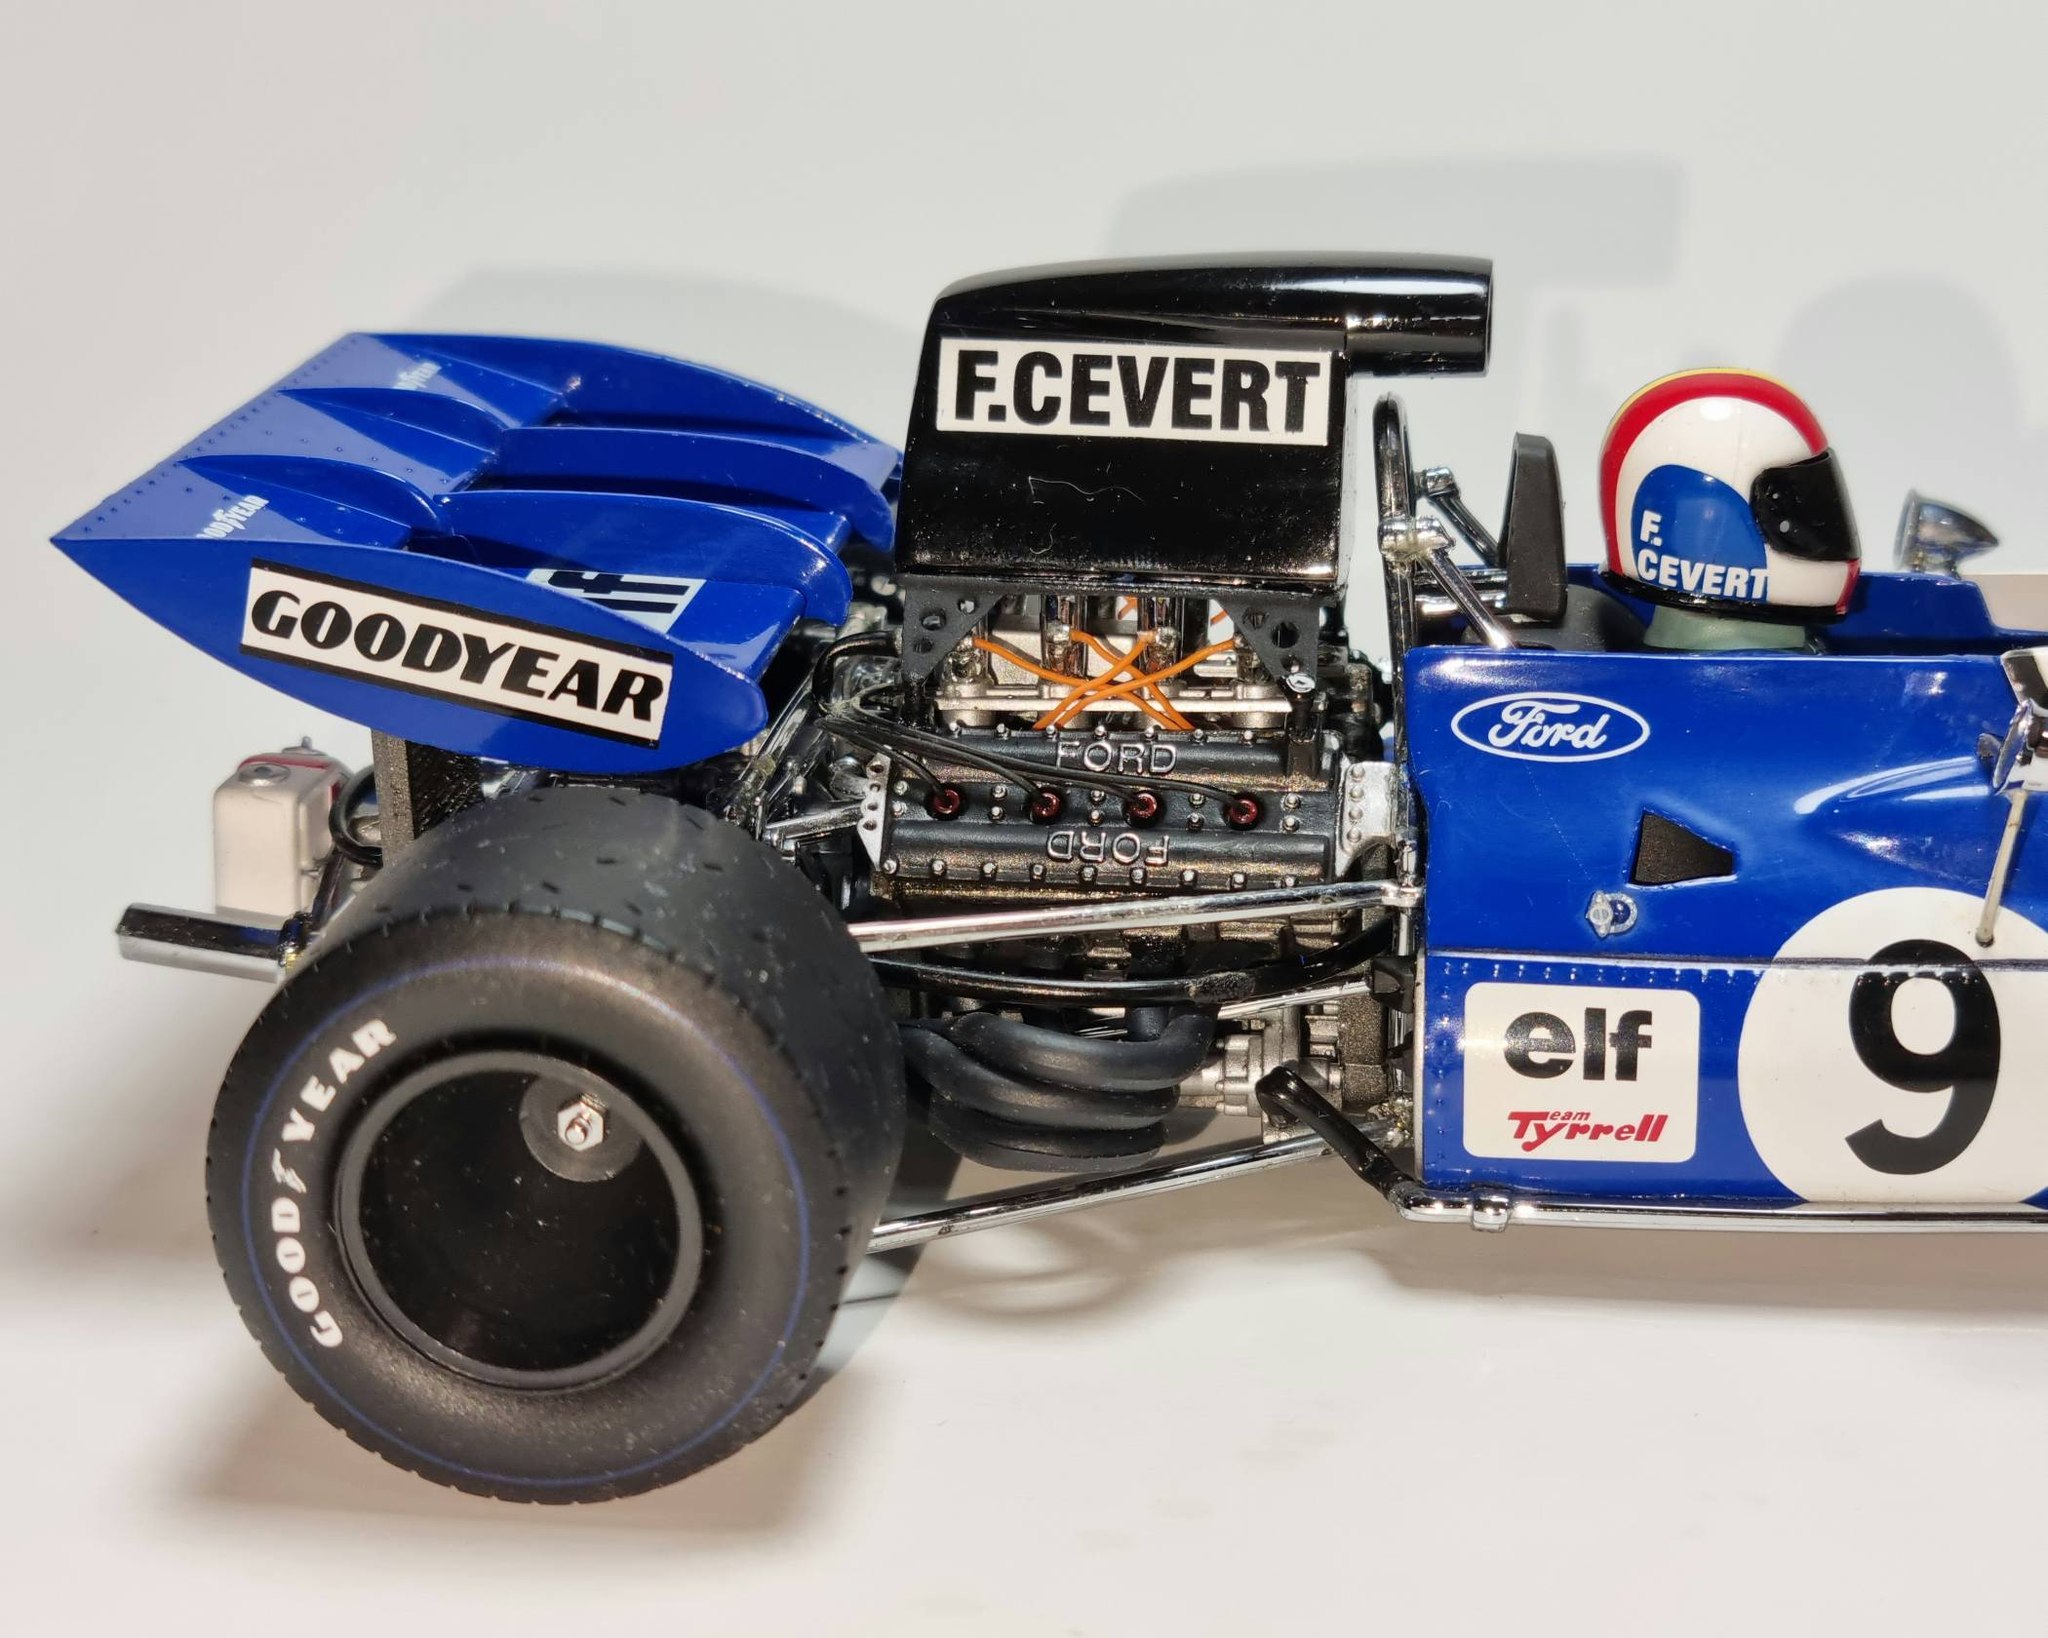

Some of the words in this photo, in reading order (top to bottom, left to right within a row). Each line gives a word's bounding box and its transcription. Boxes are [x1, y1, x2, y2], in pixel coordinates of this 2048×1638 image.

[954, 349, 1321, 433] F.CEVERT
[1640, 509, 1663, 547] F.
[1637, 548, 1769, 600] CEVERT
[251, 589, 664, 722] GOODYEAR
[1487, 700, 1611, 750] Ford
[1056, 740, 1177, 775] FORD
[1047, 830, 1171, 866] FORD
[1503, 1007, 1653, 1082] elf
[1844, 938, 2002, 1176] 9
[1507, 1110, 1669, 1152] Tyrrell
[271, 1018, 398, 1348] GOODYEAR
